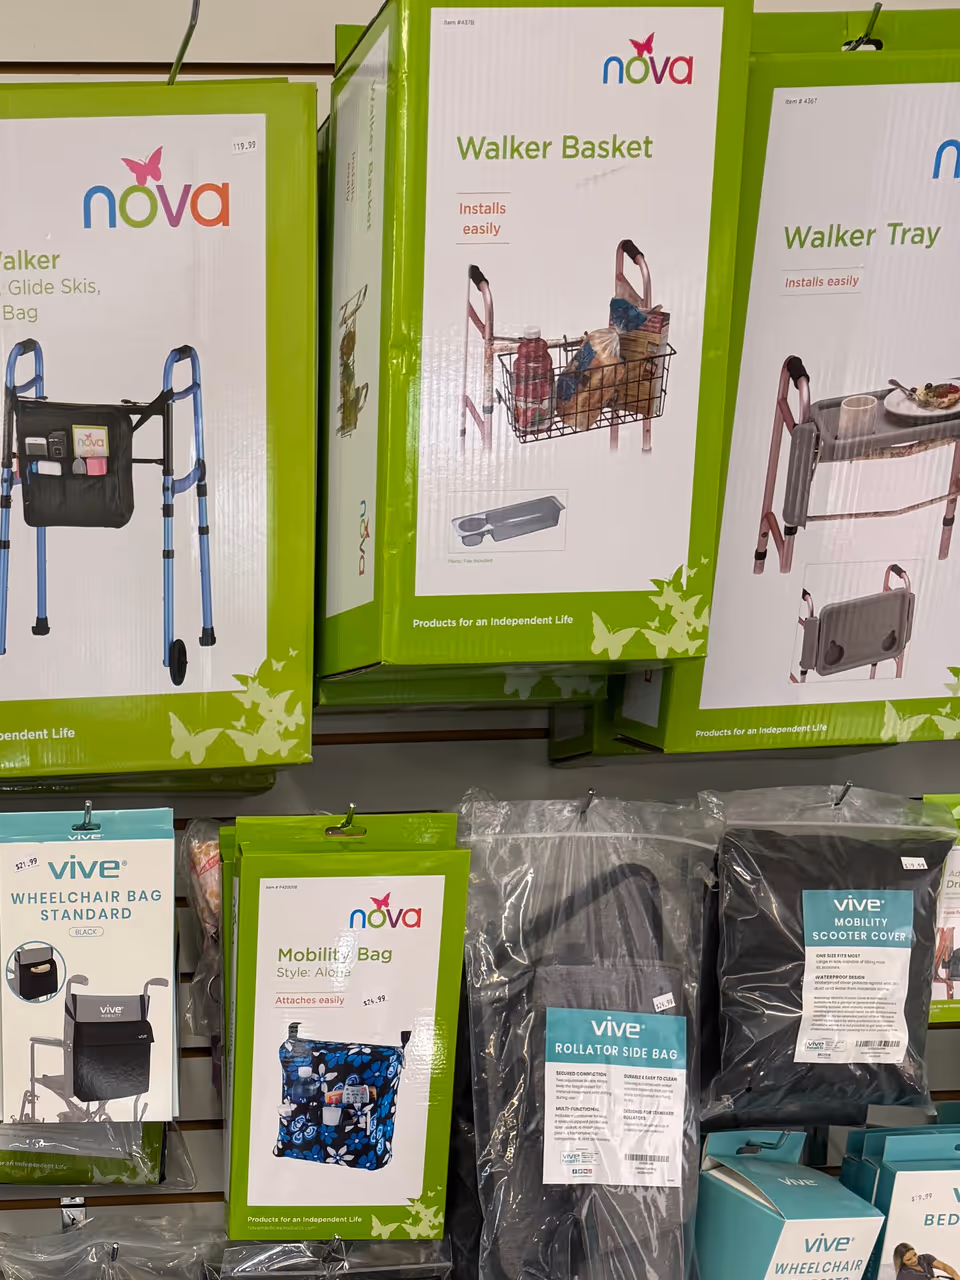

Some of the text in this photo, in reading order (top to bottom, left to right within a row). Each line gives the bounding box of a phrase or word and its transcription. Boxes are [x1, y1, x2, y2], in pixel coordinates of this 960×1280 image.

[602, 54, 694, 84] nova
[456, 135, 653, 161] Walker Basket
[82, 181, 230, 229] nova
[459, 202, 506, 215] Installs
[463, 222, 501, 237] easily
[784, 222, 941, 249] Walker Tray
[7, 278, 55, 297] Glide
[60, 277, 101, 296] Skis,
[2, 304, 39, 324] Bag
[359, 499, 370, 577] nova
[413, 615, 573, 629] Products for an Independent Life
[52, 728, 75, 741] Life
[16, 858, 38, 871] $21.99
[48, 855, 120, 879] vive
[11, 890, 162, 904] WHEELCHAIR BAG
[41, 909, 132, 921] STANDARD
[350, 908, 421, 929] nova
[835, 918, 888, 927] MOBILITY
[75, 928, 97, 936] BLACK
[813, 932, 905, 941] SCOOTER COVER
[278, 947, 393, 963] Mobility Bag
[276, 968, 311, 978] Style:
[275, 995, 345, 1005] Attaches easily
[363, 995, 386, 1006] $24.99
[591, 1016, 640, 1038] vive
[555, 1043, 678, 1059] ROLLATOR SIDE BAG
[804, 1233, 851, 1253] vive
[774, 1260, 862, 1275] WHEELCHAIR
